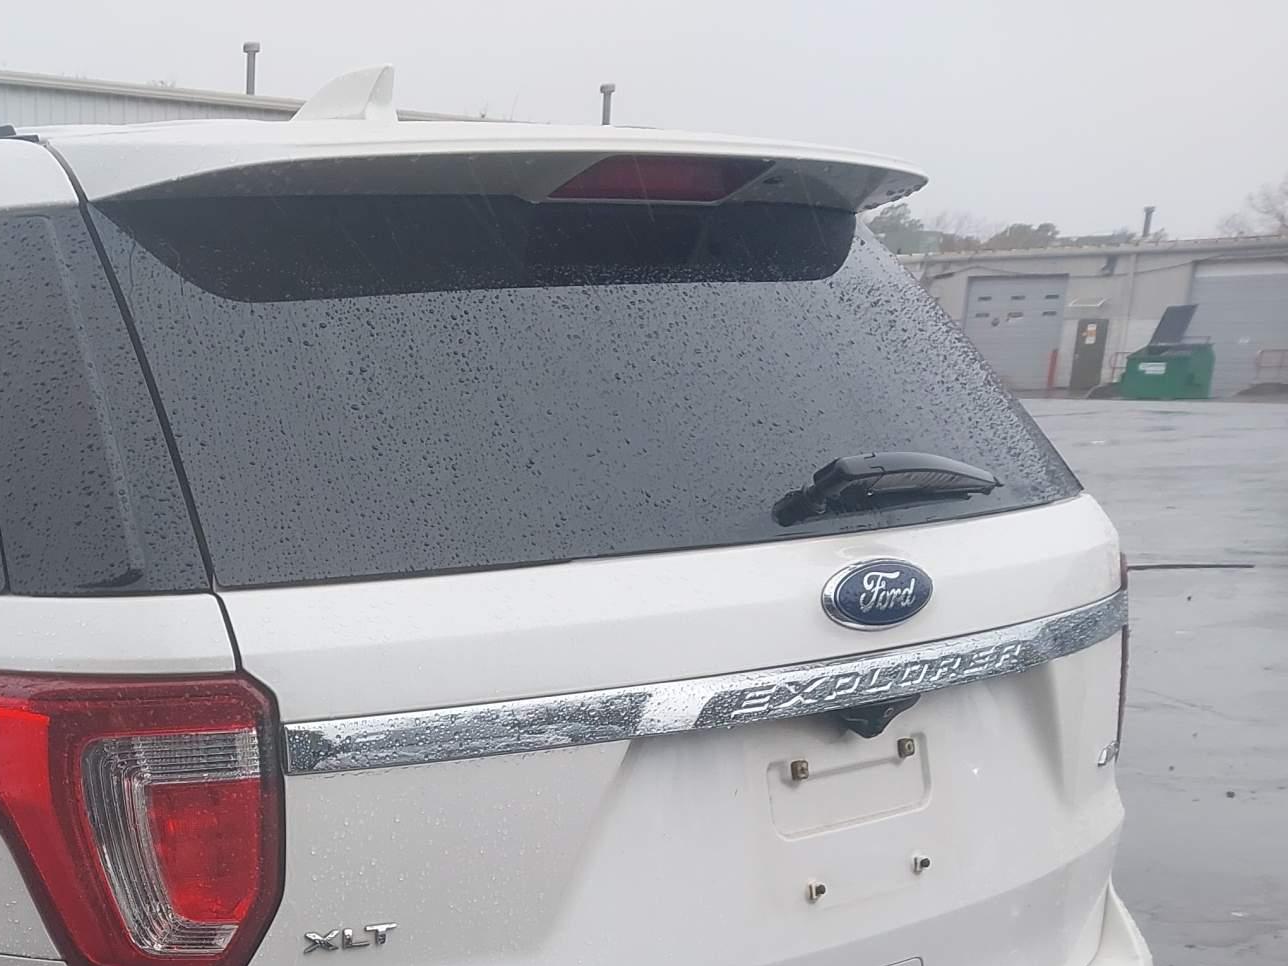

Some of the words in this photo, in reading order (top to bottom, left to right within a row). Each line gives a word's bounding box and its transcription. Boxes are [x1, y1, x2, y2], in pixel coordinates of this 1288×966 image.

[859, 571, 915, 612] Ford
[731, 643, 1025, 719] EXPLORER
[303, 921, 398, 956] XLT
